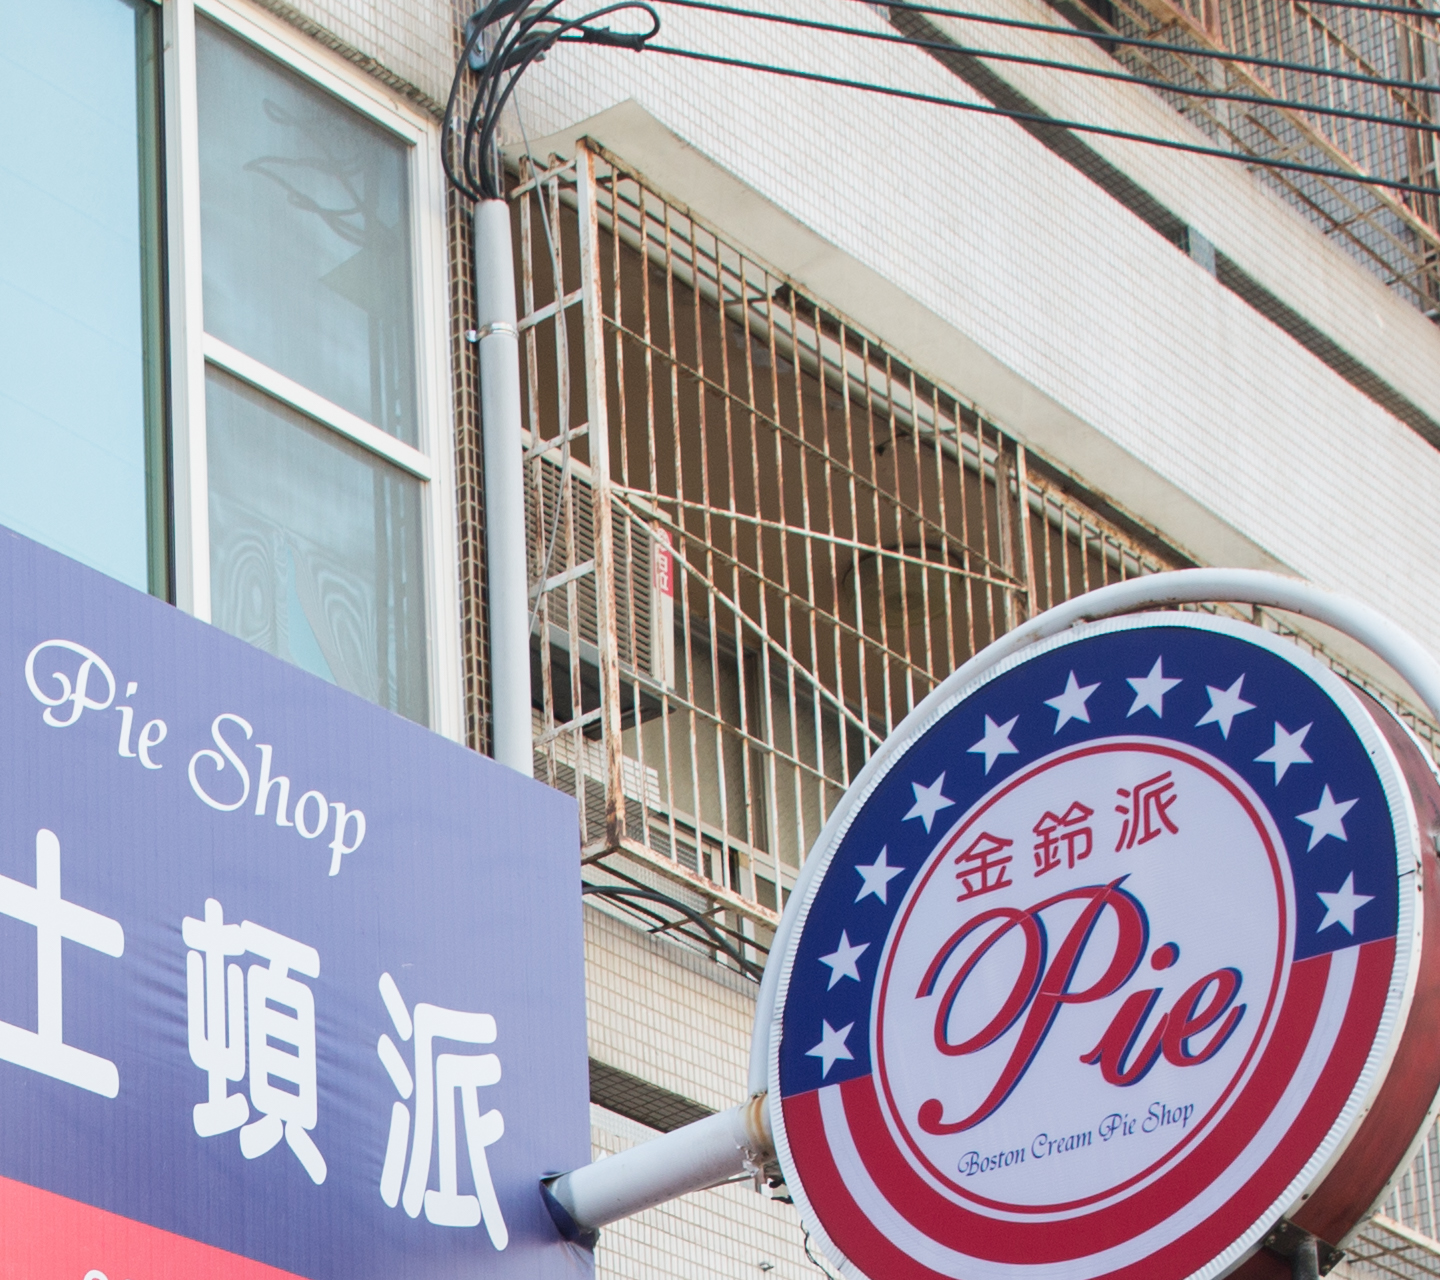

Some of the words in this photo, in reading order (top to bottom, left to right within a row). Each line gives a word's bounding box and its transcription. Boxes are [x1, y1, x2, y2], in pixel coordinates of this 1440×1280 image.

[24, 639, 167, 770] Pie
[187, 713, 367, 876] Shop
[953, 770, 1180, 903] 金鈴派
[915, 872, 1246, 1137] Pie
[957, 1149, 1025, 1177] Boston
[1031, 1131, 1093, 1160] Cream
[1098, 1112, 1137, 1142] Pie
[1141, 1101, 1194, 1134] Shop
